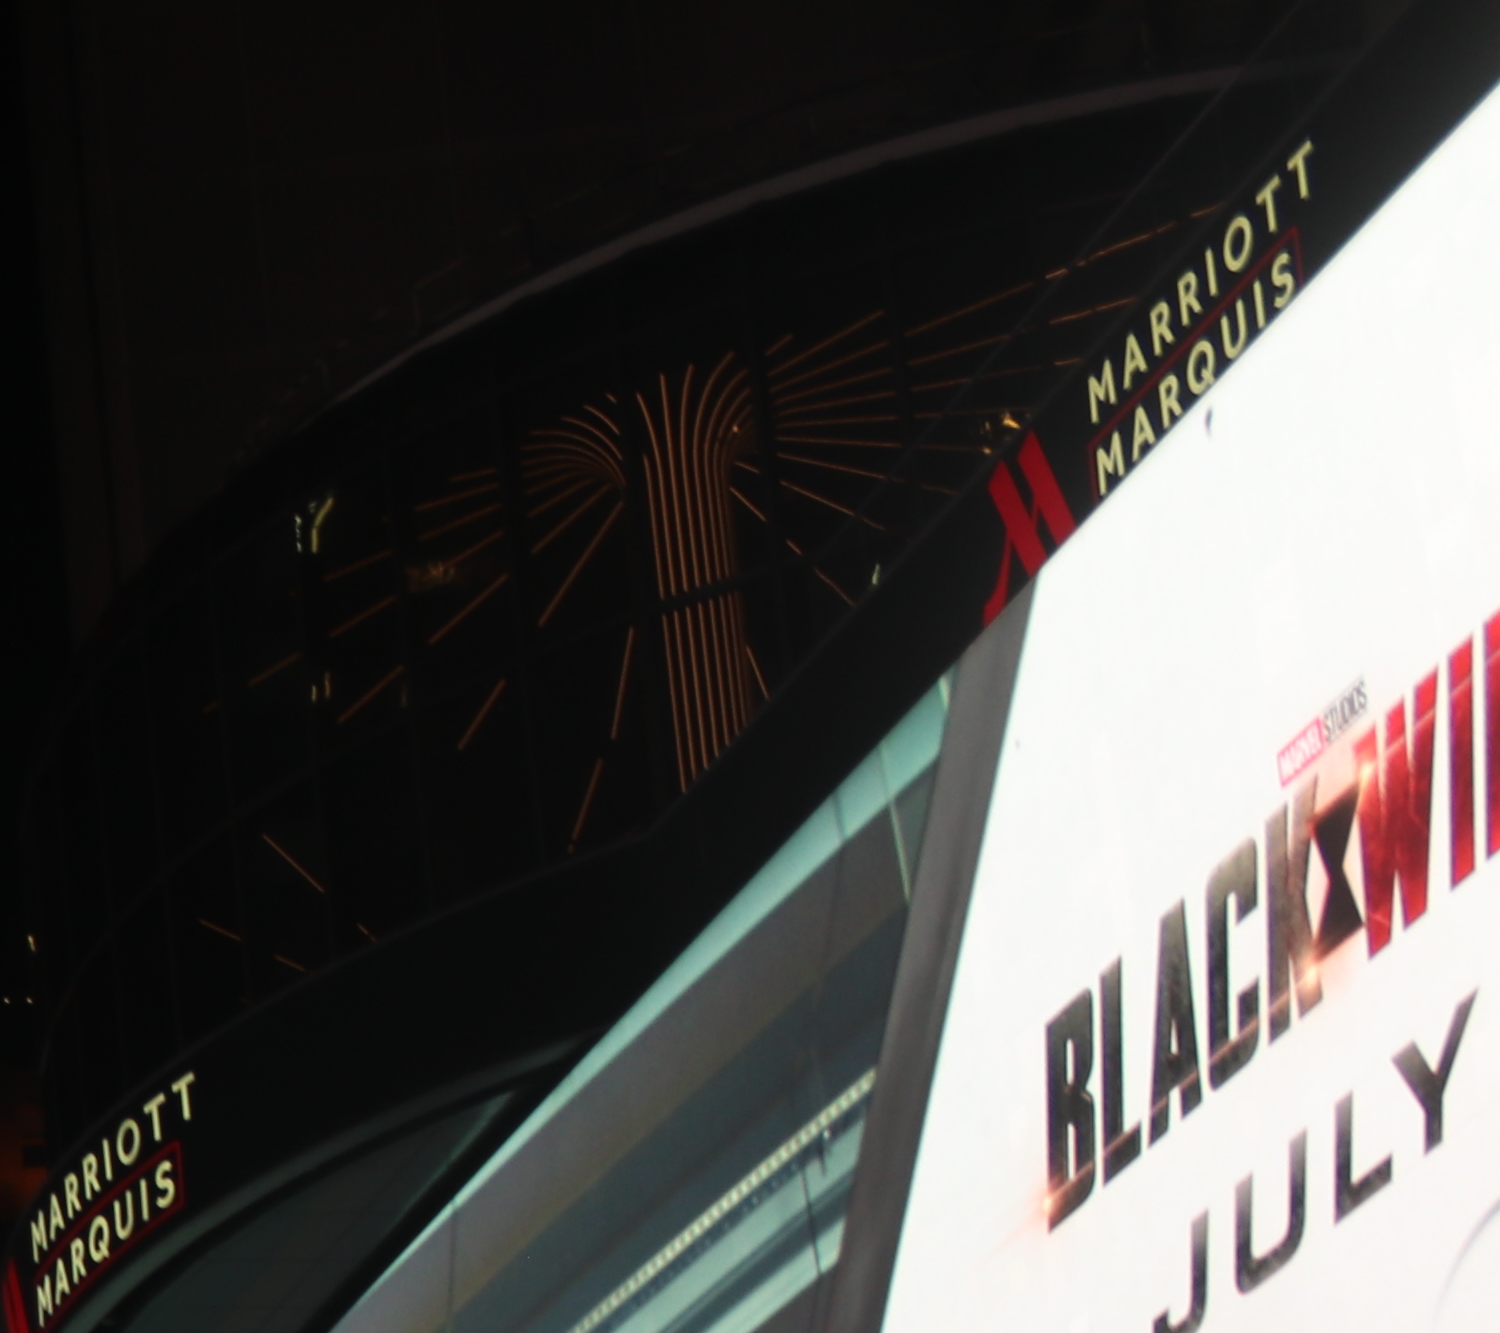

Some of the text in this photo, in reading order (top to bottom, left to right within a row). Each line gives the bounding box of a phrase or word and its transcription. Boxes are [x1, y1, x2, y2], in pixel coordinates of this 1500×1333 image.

[1087, 139, 1314, 425] MARRIOTT
[1096, 252, 1296, 497] MARQUIS
[30, 1072, 195, 1263] MARRIOTT
[36, 1161, 177, 1328] MARQUIS
